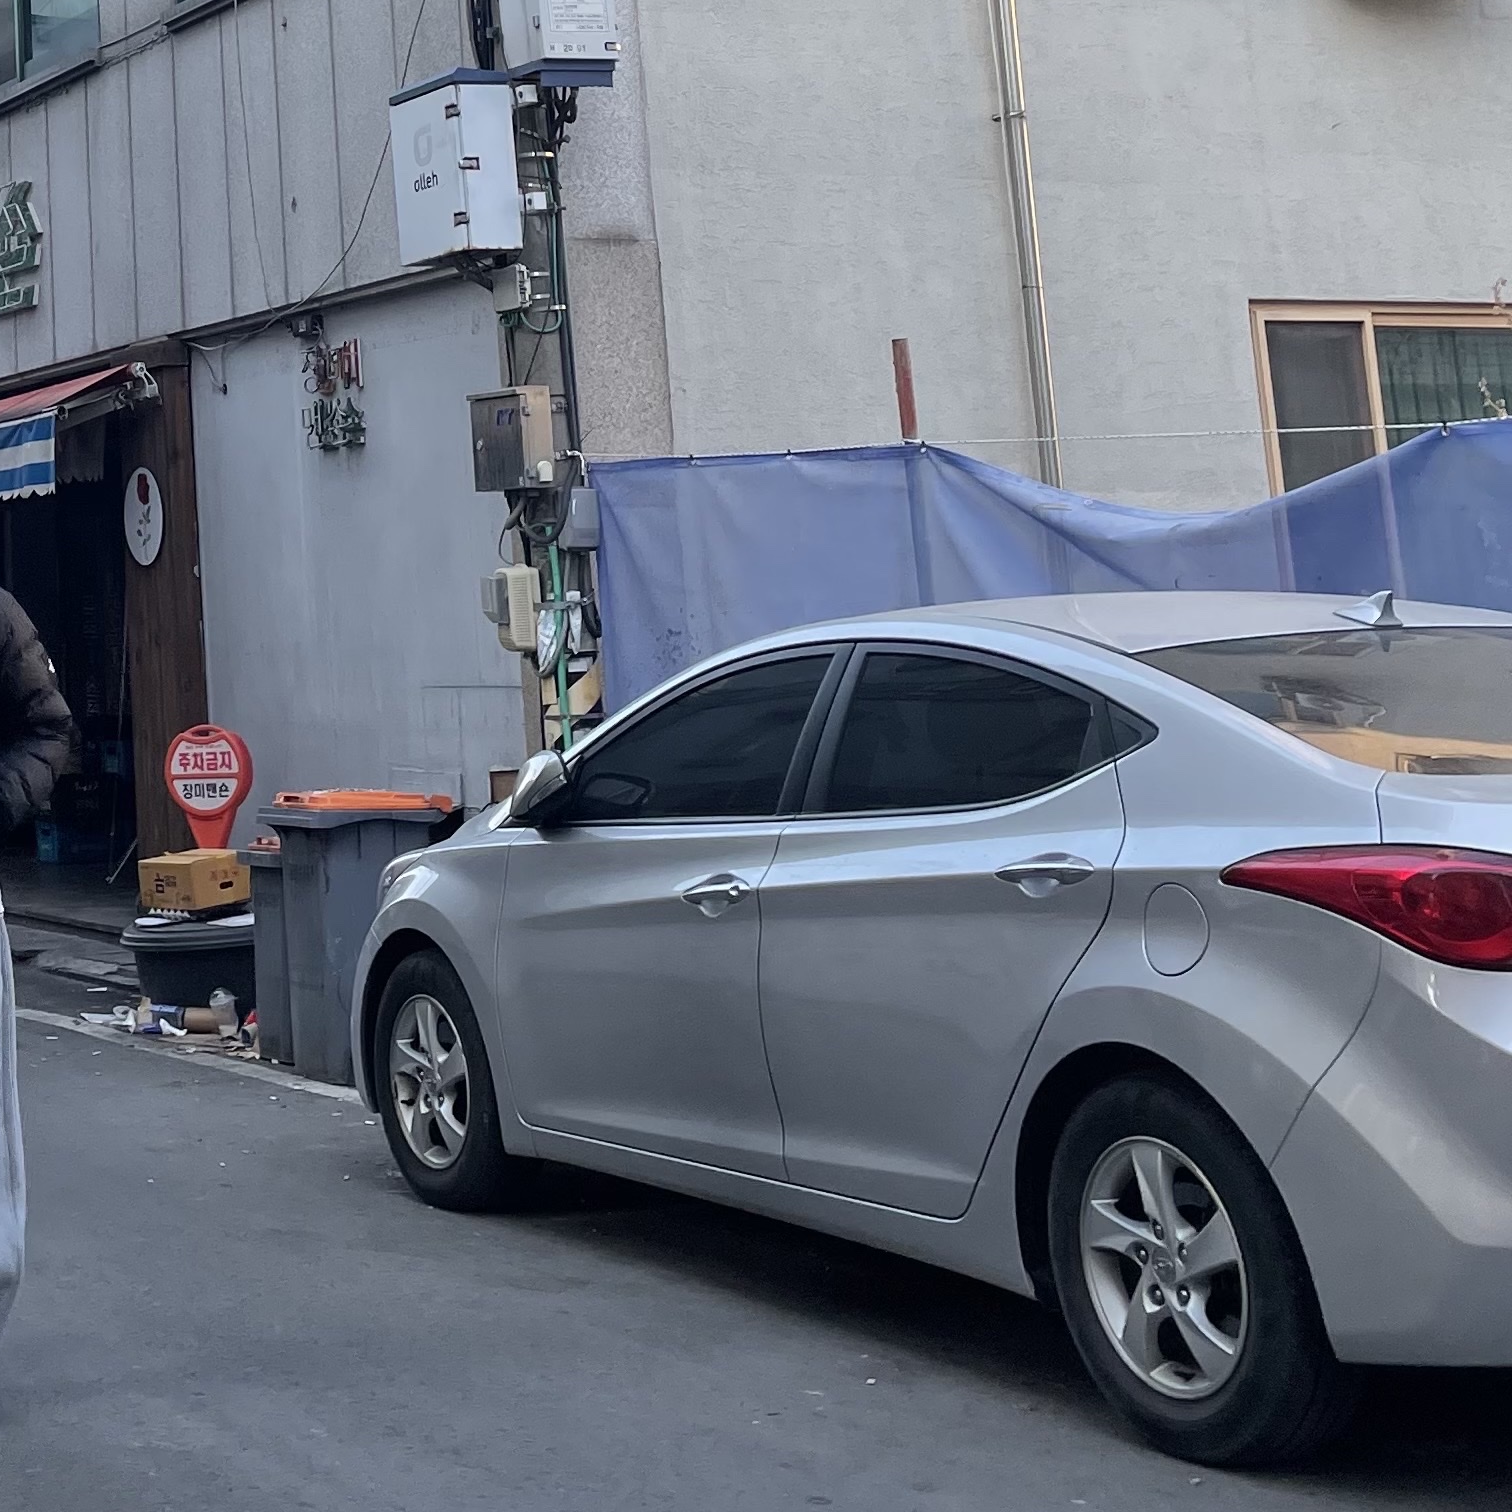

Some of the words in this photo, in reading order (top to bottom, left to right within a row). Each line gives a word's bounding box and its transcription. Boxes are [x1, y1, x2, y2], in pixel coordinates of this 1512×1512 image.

[413, 170, 439, 192] olleh
[179, 751, 233, 772] 주차금지
[182, 783, 229, 799] 장미맨숀
